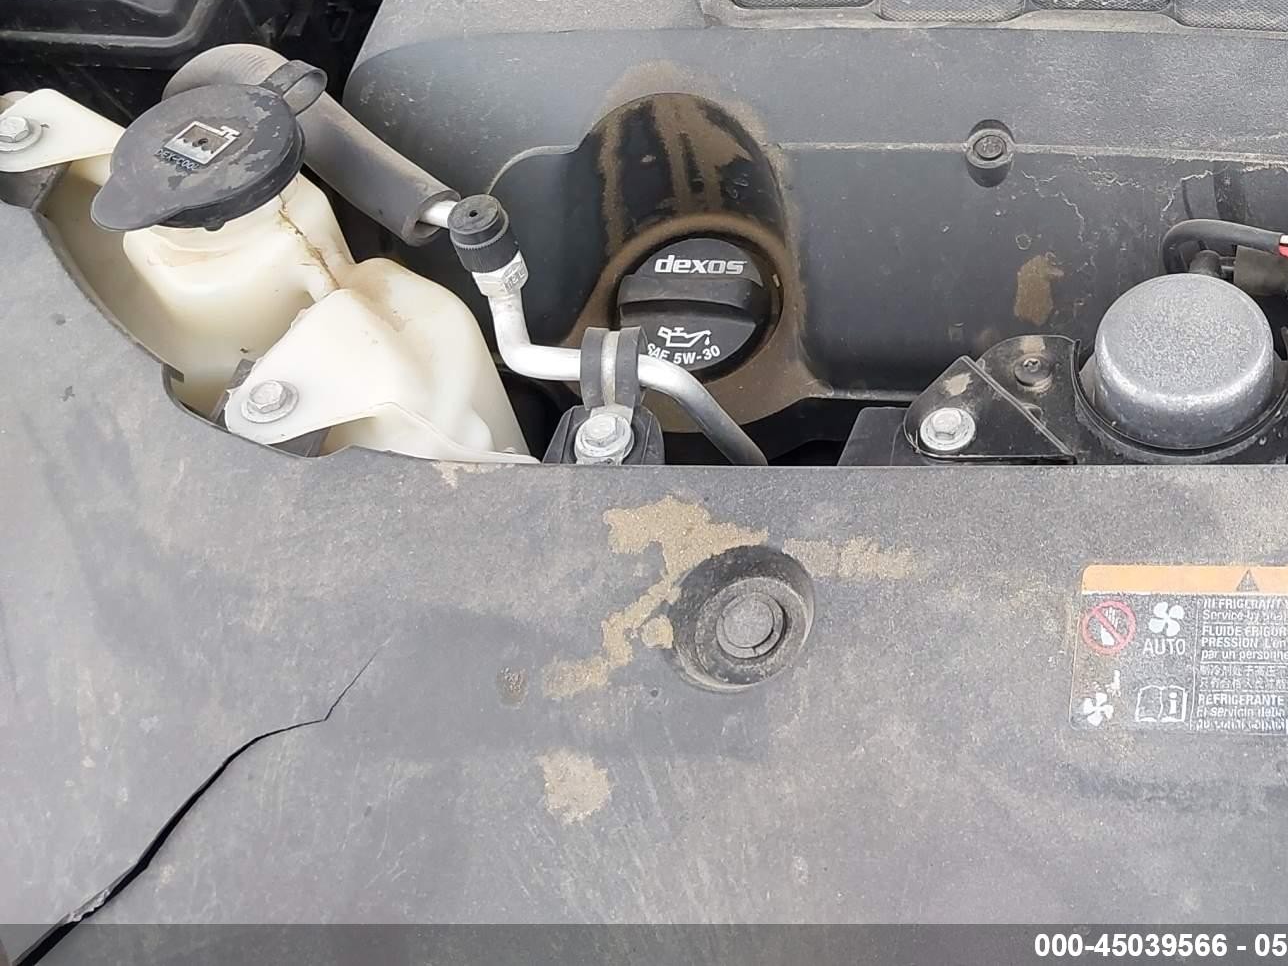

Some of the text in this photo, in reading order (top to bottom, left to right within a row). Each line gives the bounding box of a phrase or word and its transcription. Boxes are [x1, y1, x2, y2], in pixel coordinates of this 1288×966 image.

[654, 254, 746, 275] dexos
[646, 343, 721, 365] SAE 5W-30
[1201, 625, 1243, 637] FLUIDE
[1142, 638, 1187, 656] AUTO
[1201, 650, 1219, 662] par
[1222, 650, 1236, 660] un
[1198, 693, 1285, 706] REFRIGERANTE
